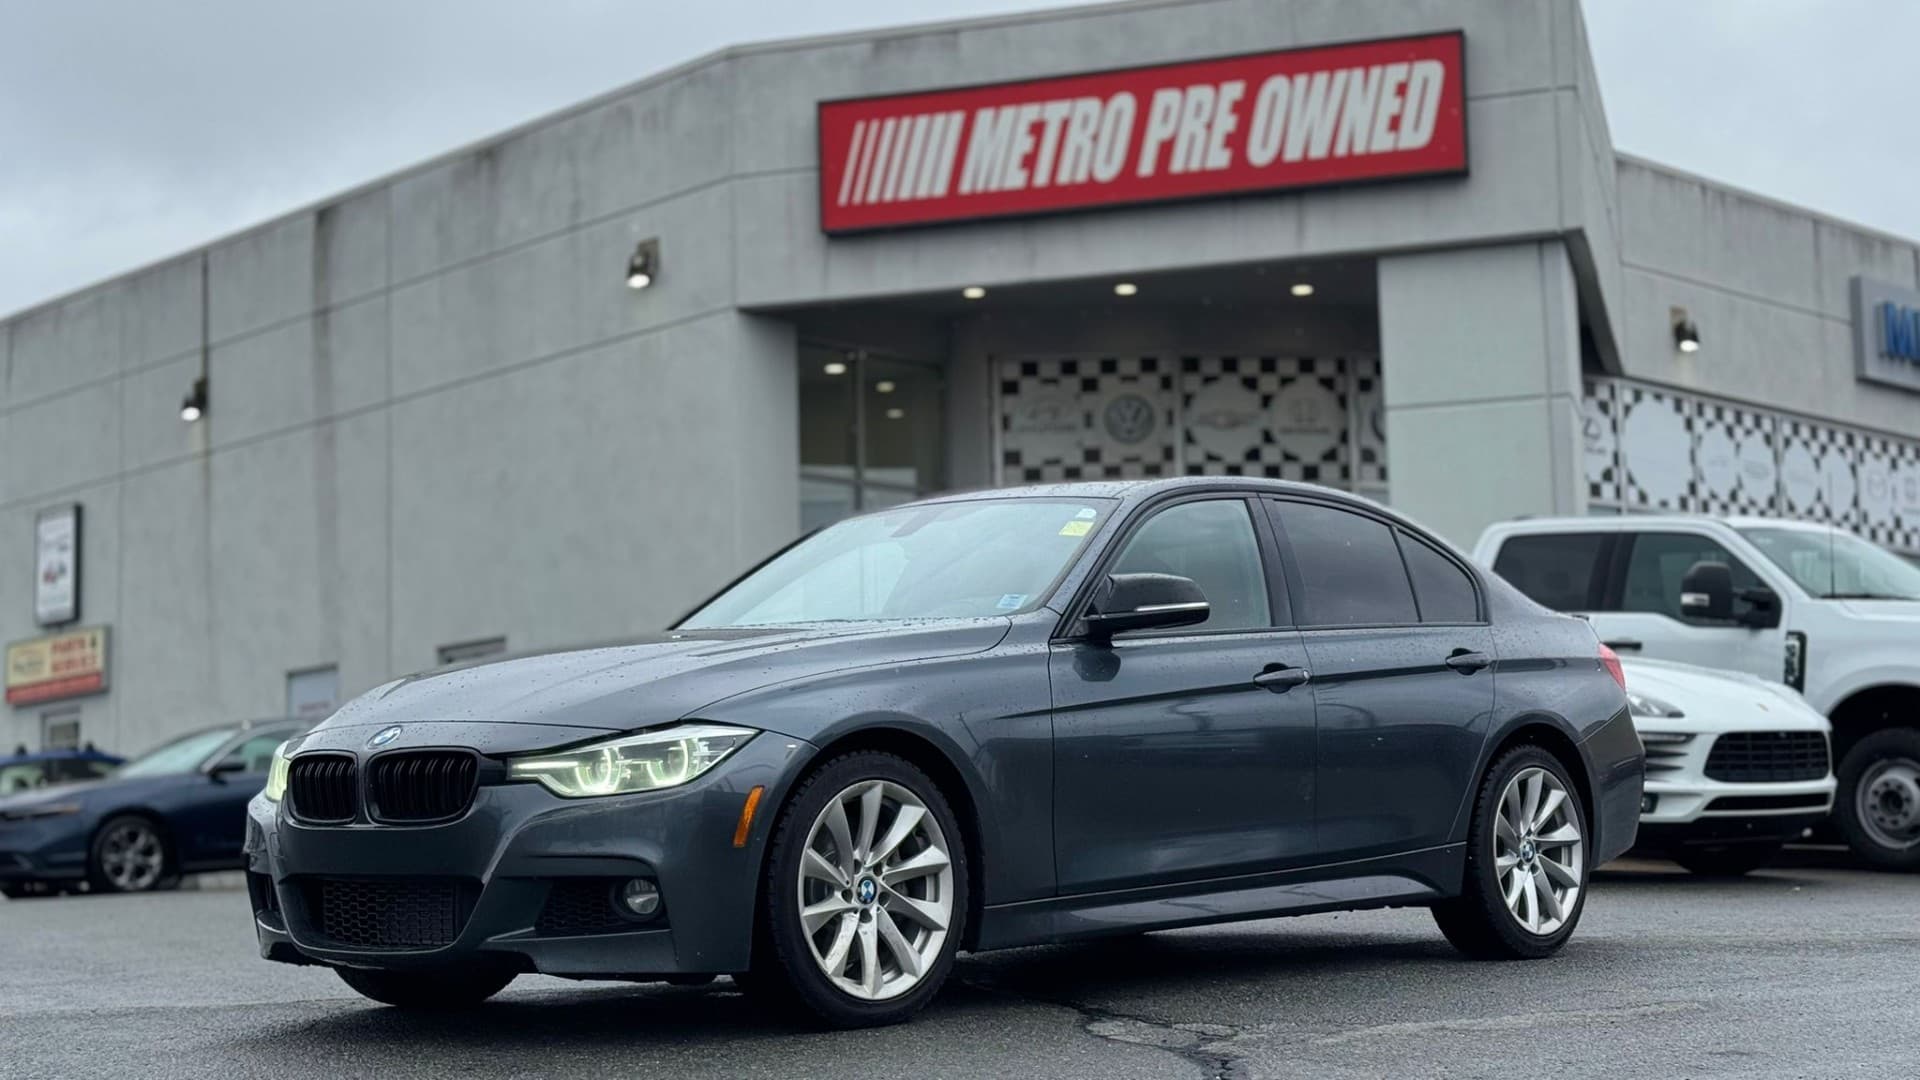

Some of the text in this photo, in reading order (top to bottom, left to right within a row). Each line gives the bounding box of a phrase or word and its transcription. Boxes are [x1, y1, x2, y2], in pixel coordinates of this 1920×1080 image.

[959, 60, 1445, 195] METRO PRE OWNED
